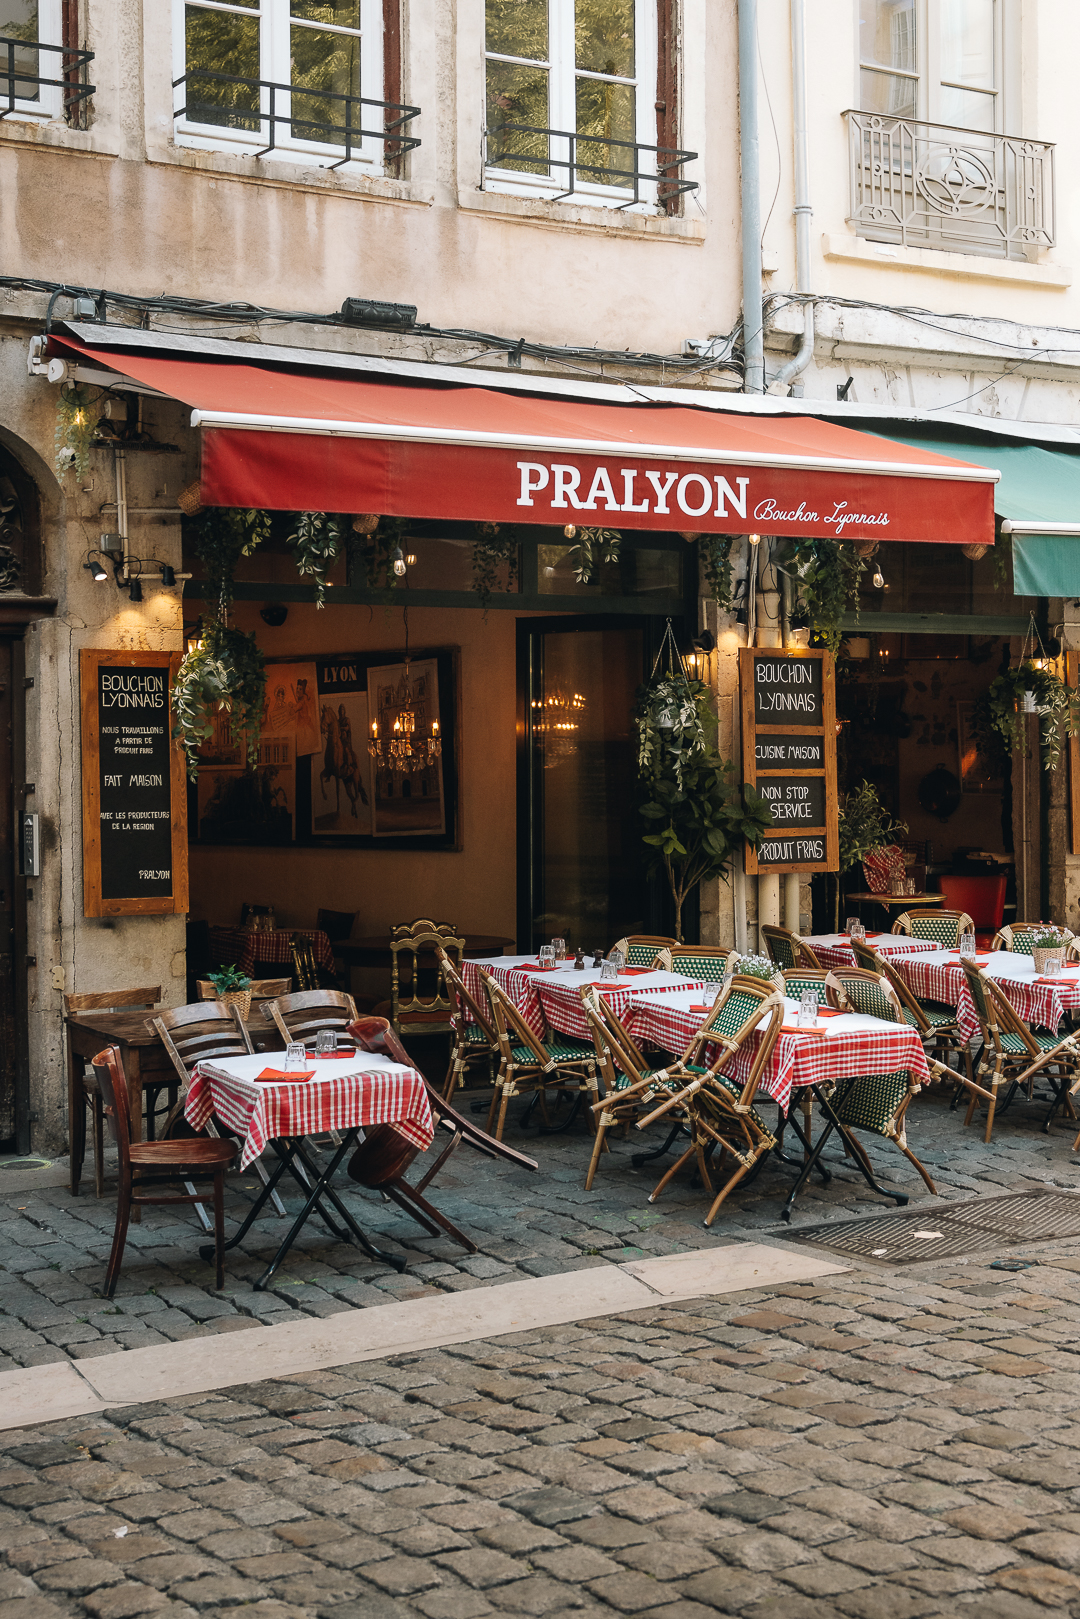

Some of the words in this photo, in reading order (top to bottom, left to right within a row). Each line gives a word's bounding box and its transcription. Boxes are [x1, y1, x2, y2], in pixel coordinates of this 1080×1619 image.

[516, 461, 750, 518] PRALYON
[754, 498, 820, 520] Bouchon
[824, 501, 890, 534] Lyonnais
[324, 665, 357, 683] LYON
[757, 664, 812, 684] BOUCHON
[102, 674, 164, 692] BOUCHON
[102, 692, 164, 708] LYONNAIS
[758, 692, 816, 712] LYONNAIS
[121, 726, 164, 734] TRAVAILLONS
[114, 746, 138, 754] PRODUIT
[754, 746, 786, 759] CUISINE
[788, 746, 820, 760] MAISON
[104, 774, 122, 786] FAIT
[129, 774, 162, 786] MAISON
[762, 786, 782, 799] NON
[786, 786, 809, 799] STOP
[116, 812, 126, 820] LES
[128, 812, 170, 820] PRODUCTEURS
[770, 802, 812, 818] SERVICE
[758, 842, 794, 860] PRODUIT
[797, 840, 824, 858] FRAIS
[138, 870, 170, 880] PRALYON
